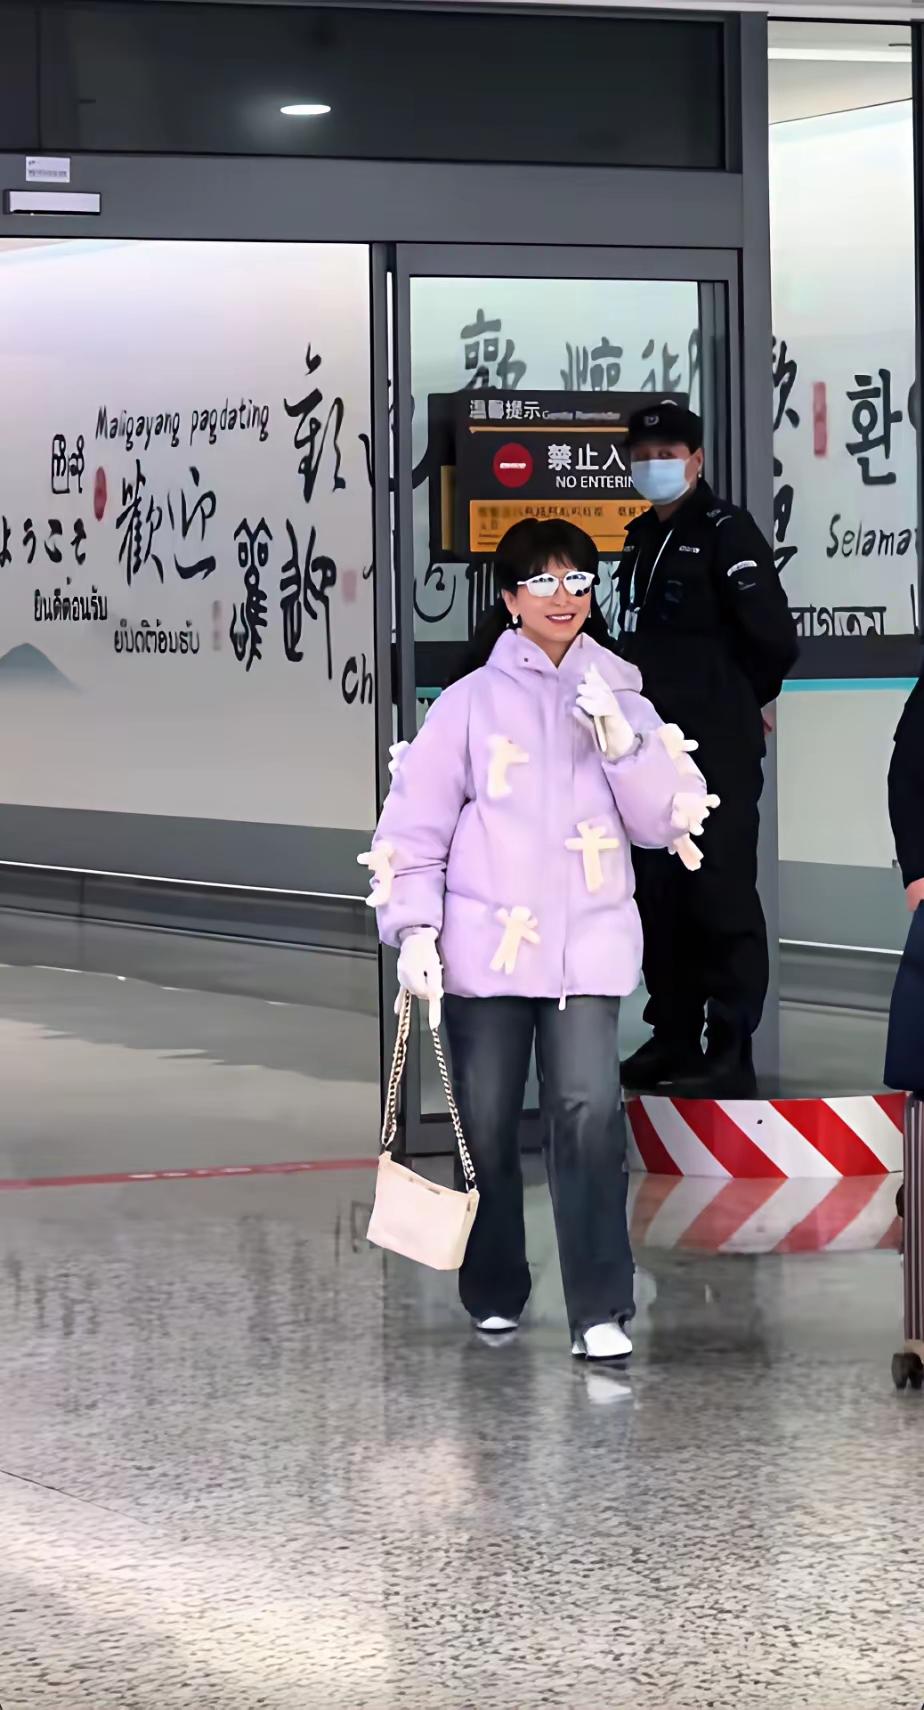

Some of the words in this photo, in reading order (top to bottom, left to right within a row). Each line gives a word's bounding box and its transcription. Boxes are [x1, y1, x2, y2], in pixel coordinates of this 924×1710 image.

[95, 405, 180, 451] Maligayang
[190, 397, 270, 442] pagdating
[846, 368, 914, 487] 환
[555, 475, 577, 489] NO
[826, 514, 917, 558] Selama
